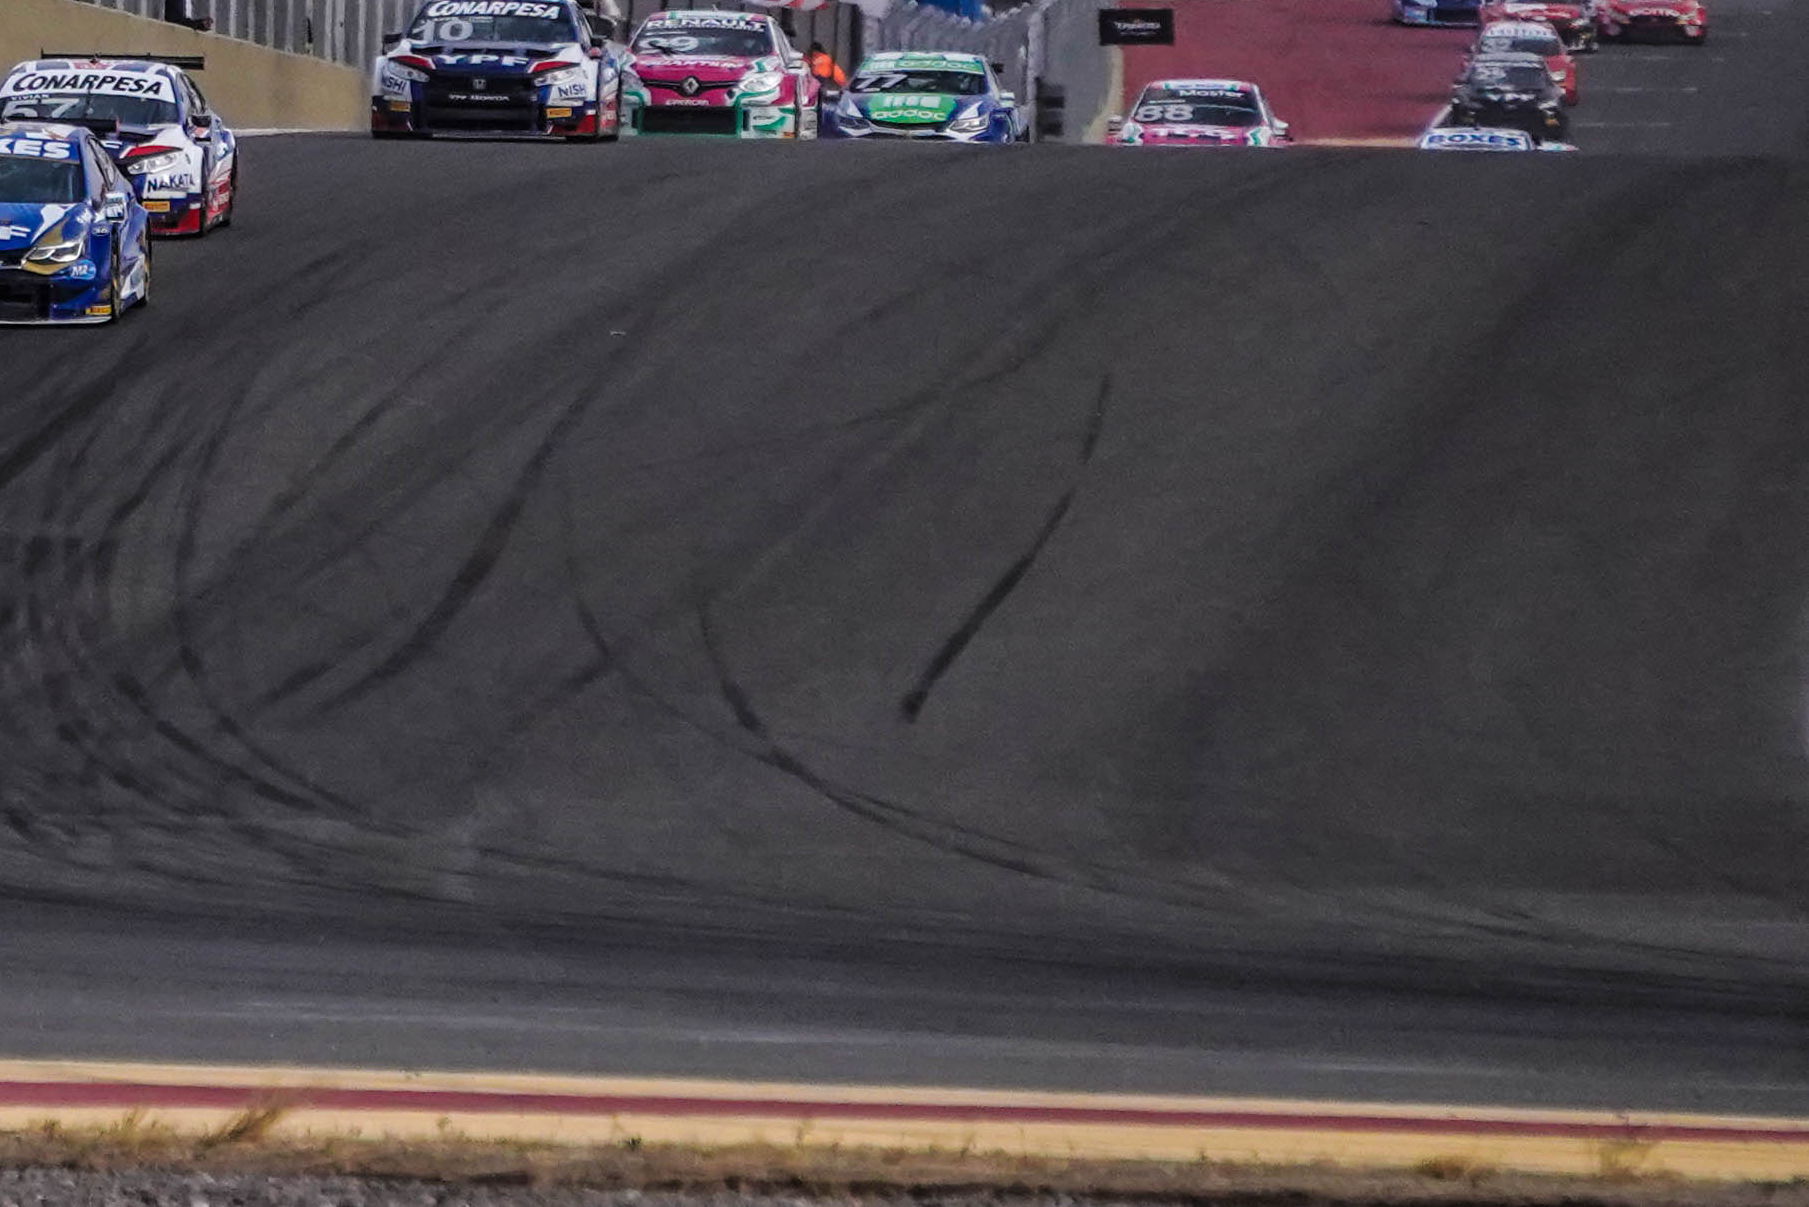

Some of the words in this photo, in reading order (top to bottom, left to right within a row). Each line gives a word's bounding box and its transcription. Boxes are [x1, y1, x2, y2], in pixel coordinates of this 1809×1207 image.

[428, 0, 561, 20] CONARPESA
[412, 19, 474, 44] 10
[646, 18, 767, 32] RENAULT
[442, 54, 529, 66] YPF
[12, 73, 163, 95] CONARPESA
[4, 98, 79, 118] 57
